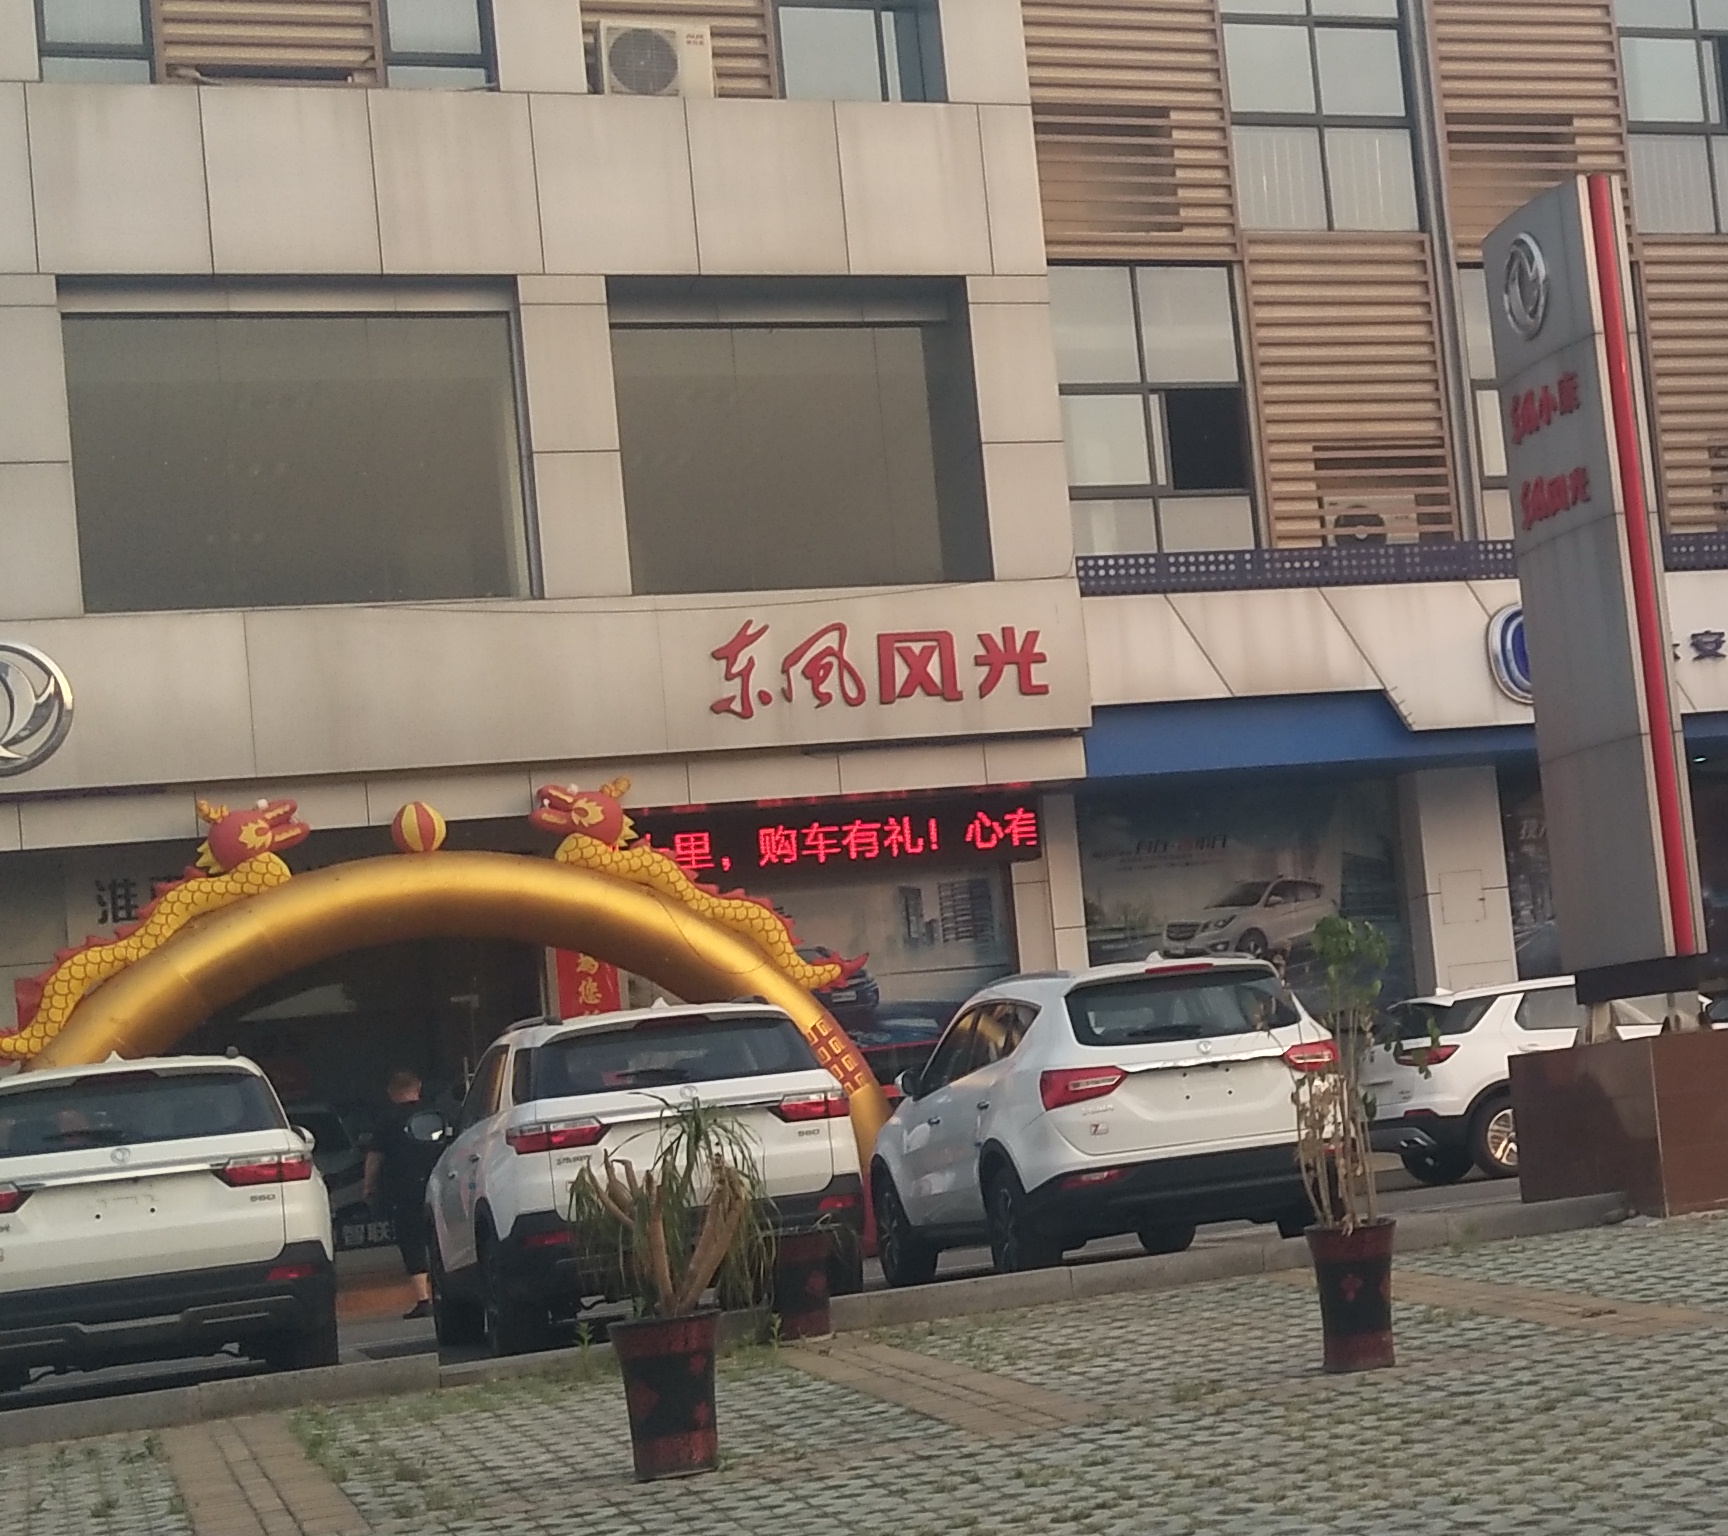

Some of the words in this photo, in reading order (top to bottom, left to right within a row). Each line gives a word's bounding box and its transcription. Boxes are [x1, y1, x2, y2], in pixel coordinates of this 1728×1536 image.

[710, 618, 1050, 720] 东风风光
[576, 952, 603, 1015] 为您
